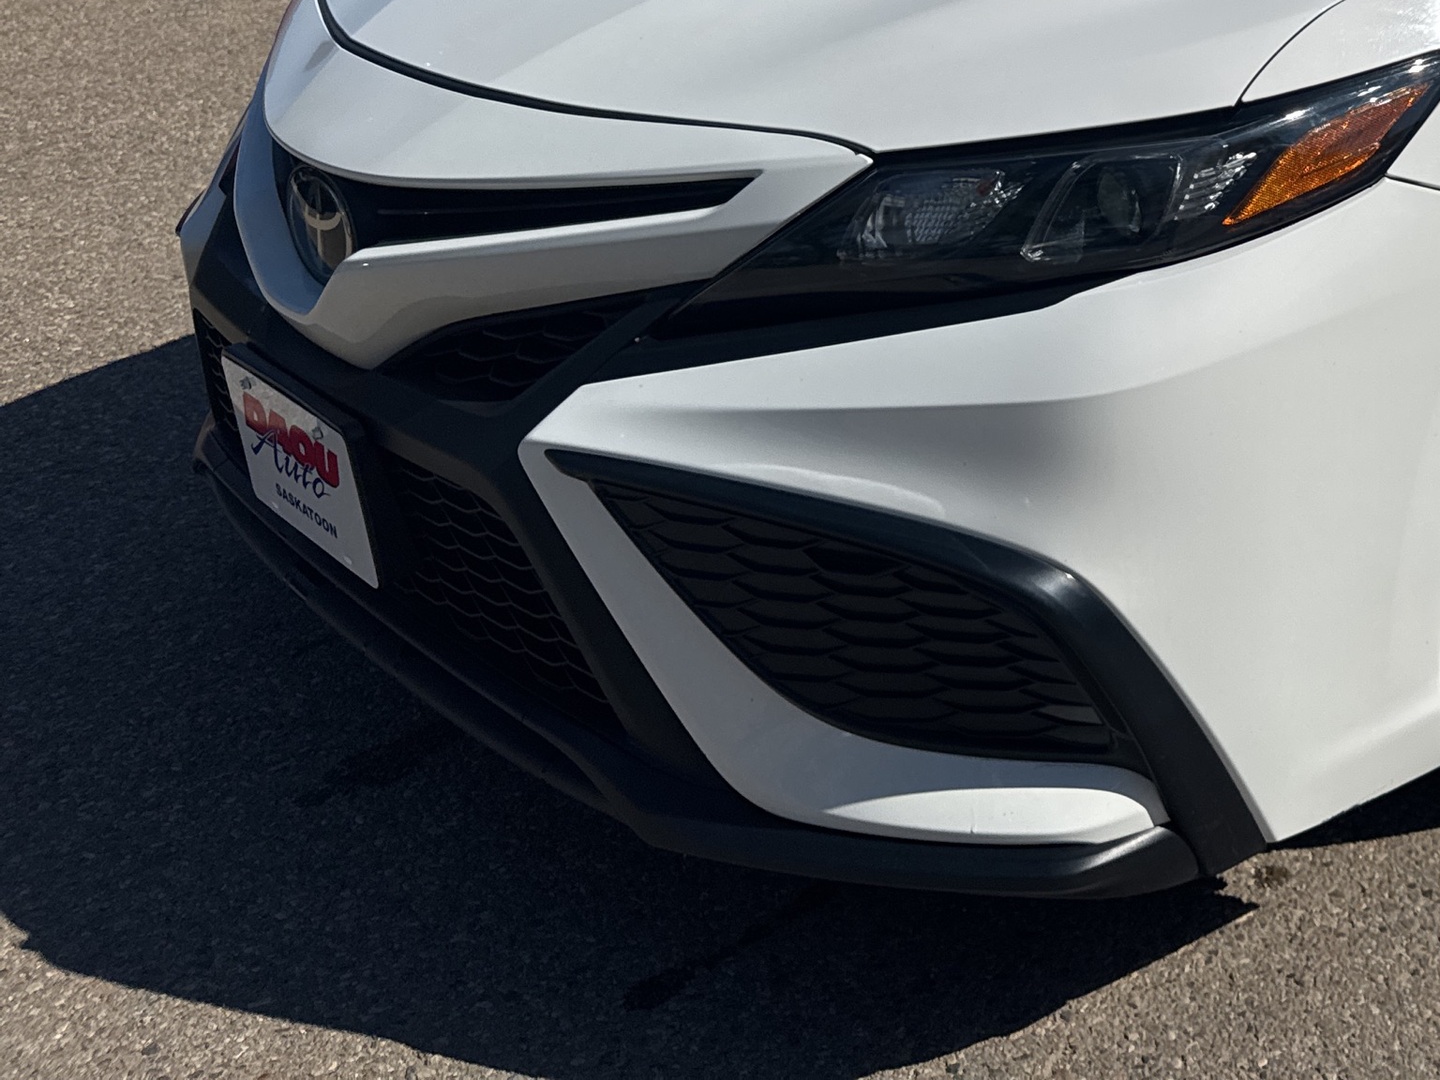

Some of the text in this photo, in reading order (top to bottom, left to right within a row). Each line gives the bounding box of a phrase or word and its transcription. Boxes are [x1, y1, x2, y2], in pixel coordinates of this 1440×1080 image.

[243, 391, 340, 488] DAOU
[251, 429, 330, 498] Auto
[275, 483, 338, 538] SASKATOON
